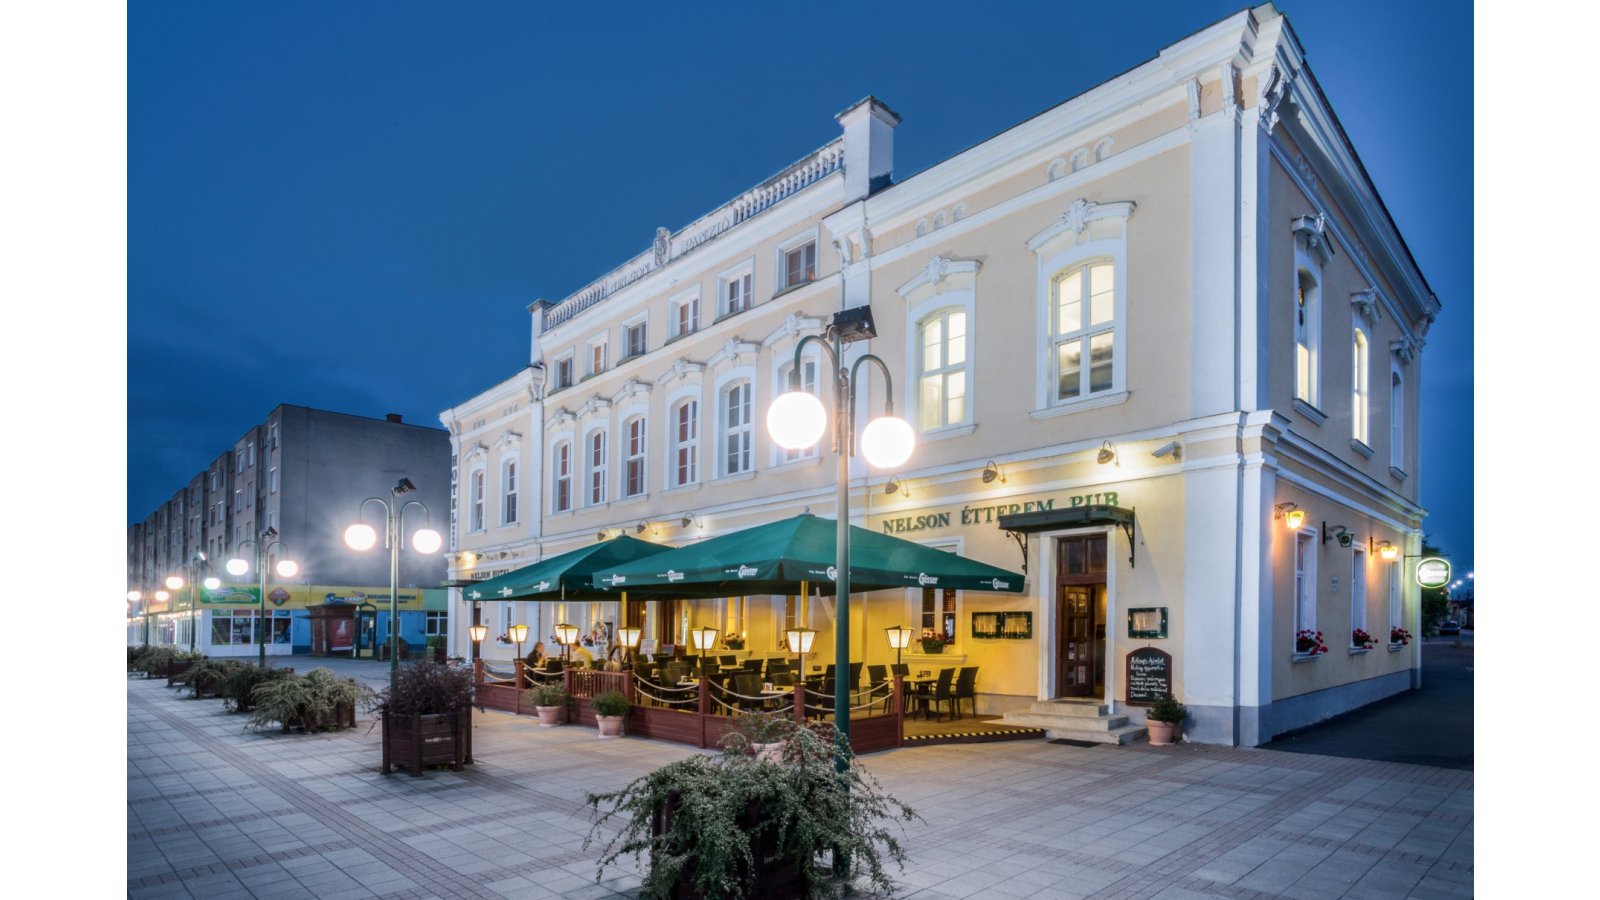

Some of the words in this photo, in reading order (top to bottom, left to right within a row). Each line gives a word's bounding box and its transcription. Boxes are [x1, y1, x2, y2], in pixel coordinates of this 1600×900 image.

[882, 511, 951, 534] NELSON
[1069, 491, 1119, 509] PUB
[470, 571, 491, 580] NELSON
